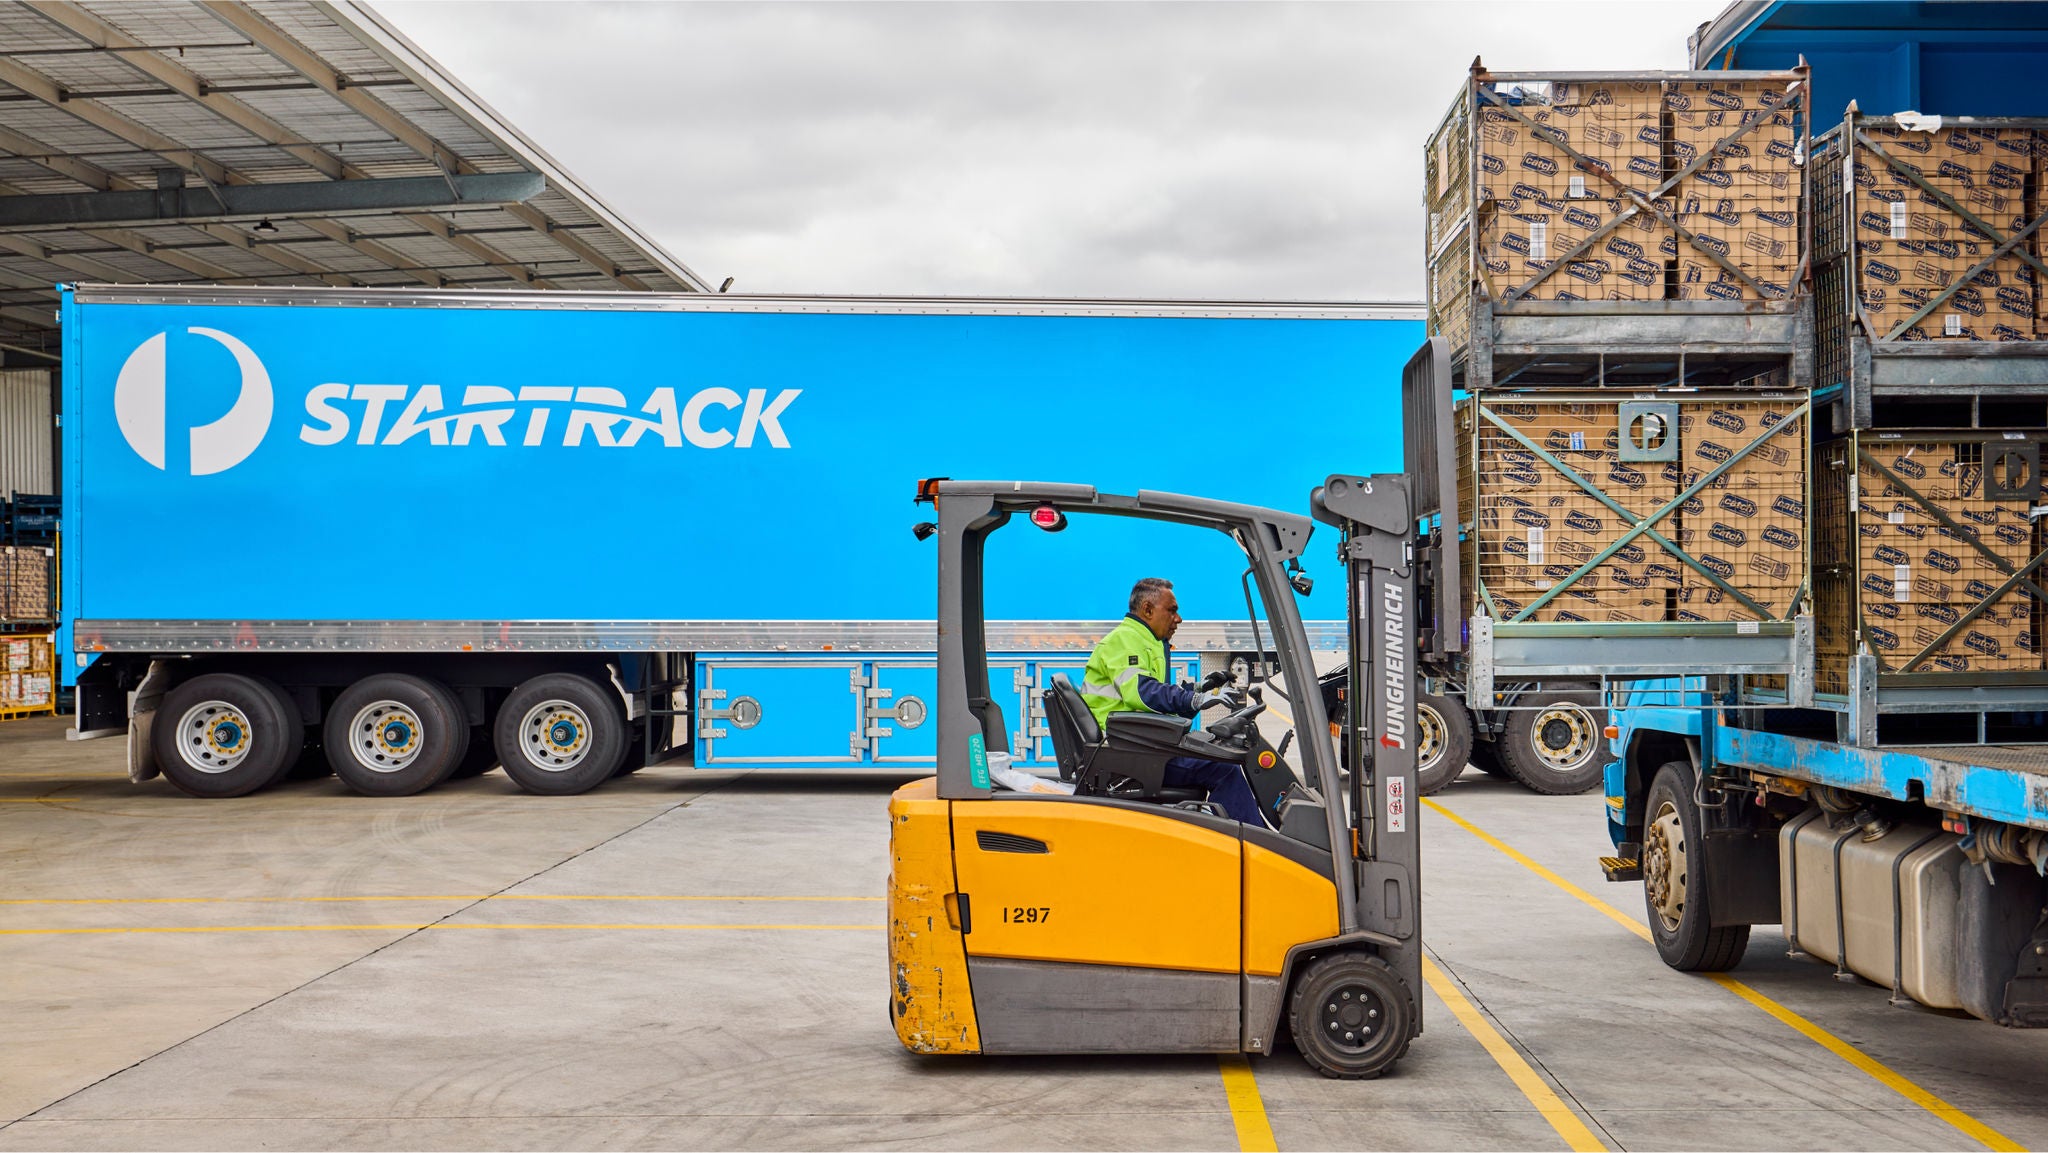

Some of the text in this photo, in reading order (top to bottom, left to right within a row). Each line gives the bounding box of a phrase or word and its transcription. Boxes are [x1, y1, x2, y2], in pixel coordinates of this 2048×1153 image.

[1642, 131, 1661, 143] cat
[1484, 159, 1503, 171] tch
[1525, 157, 1557, 174] catch
[1569, 212, 1600, 228] catch
[1611, 243, 1641, 257] catch
[1571, 265, 1601, 279] catch
[1631, 260, 1660, 274] catch
[1869, 265, 1897, 279] catch
[1710, 285, 1741, 299] catch
[300, 383, 803, 449] STARTRACK
[1713, 413, 1742, 429] catch
[1701, 446, 1730, 460] catch
[1896, 461, 1923, 473] catch
[1724, 498, 1755, 512] catch
[1519, 511, 1546, 526] catch
[1570, 516, 1600, 530] catch
[1713, 528, 1742, 543] catch
[1766, 531, 1795, 545] catch
[1878, 550, 1906, 564] catch
[1929, 554, 1957, 568] catch
[1702, 560, 1731, 574] catch
[1968, 636, 1996, 651] catch
[1382, 583, 1406, 750] JUNGHEINRICH
[1003, 907, 1050, 923] 1297
